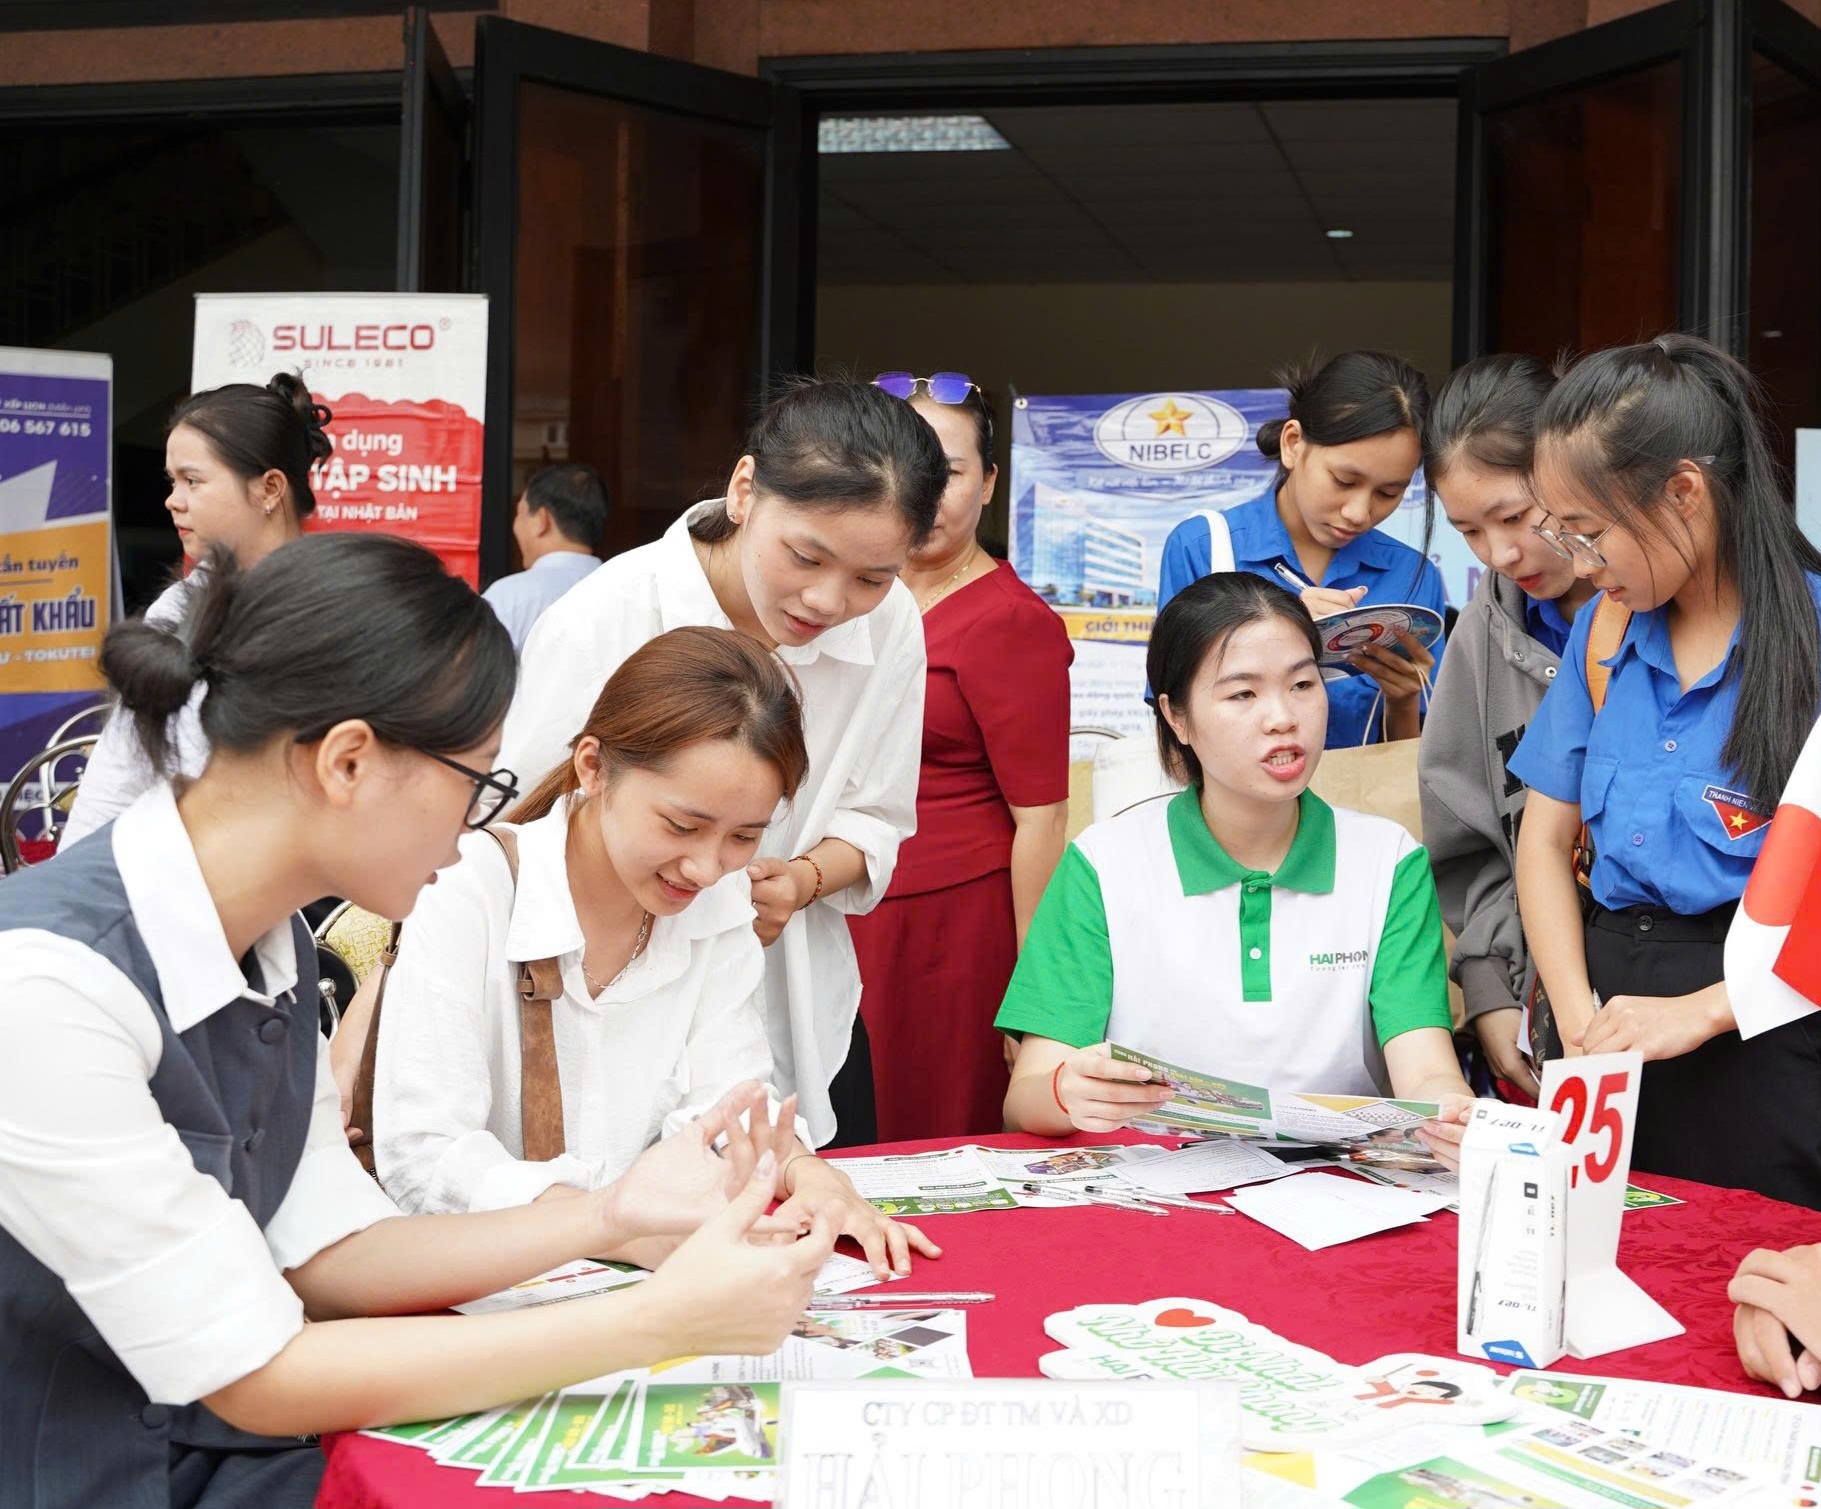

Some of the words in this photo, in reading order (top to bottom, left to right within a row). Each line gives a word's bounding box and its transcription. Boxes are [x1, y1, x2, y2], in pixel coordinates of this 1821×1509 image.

[272, 324, 435, 351] SULECO
[303, 358, 356, 369] SINCE
[24, 419, 56, 435] 567
[59, 421, 92, 437] 615
[342, 429, 403, 457] dụng
[1129, 443, 1212, 461] NIBELC
[311, 457, 370, 499] TẬP
[377, 464, 458, 493] SINH
[317, 505, 339, 523] TẠI
[341, 502, 383, 524] NHẬT
[384, 501, 418, 521] BẢN
[33, 586, 96, 632] KHẨU
[1085, 616, 1118, 632] GIỚI
[1708, 790, 1732, 804] THANH
[1551, 1071, 1629, 1189] 25
[862, 1401, 915, 1427] CTY
[921, 1401, 955, 1427] CP
[1002, 1401, 1041, 1427] TM
[1052, 1395, 1092, 1427] VÀ
[1095, 1401, 1134, 1427] XD
[944, 1449, 1187, 1509] PHONG
